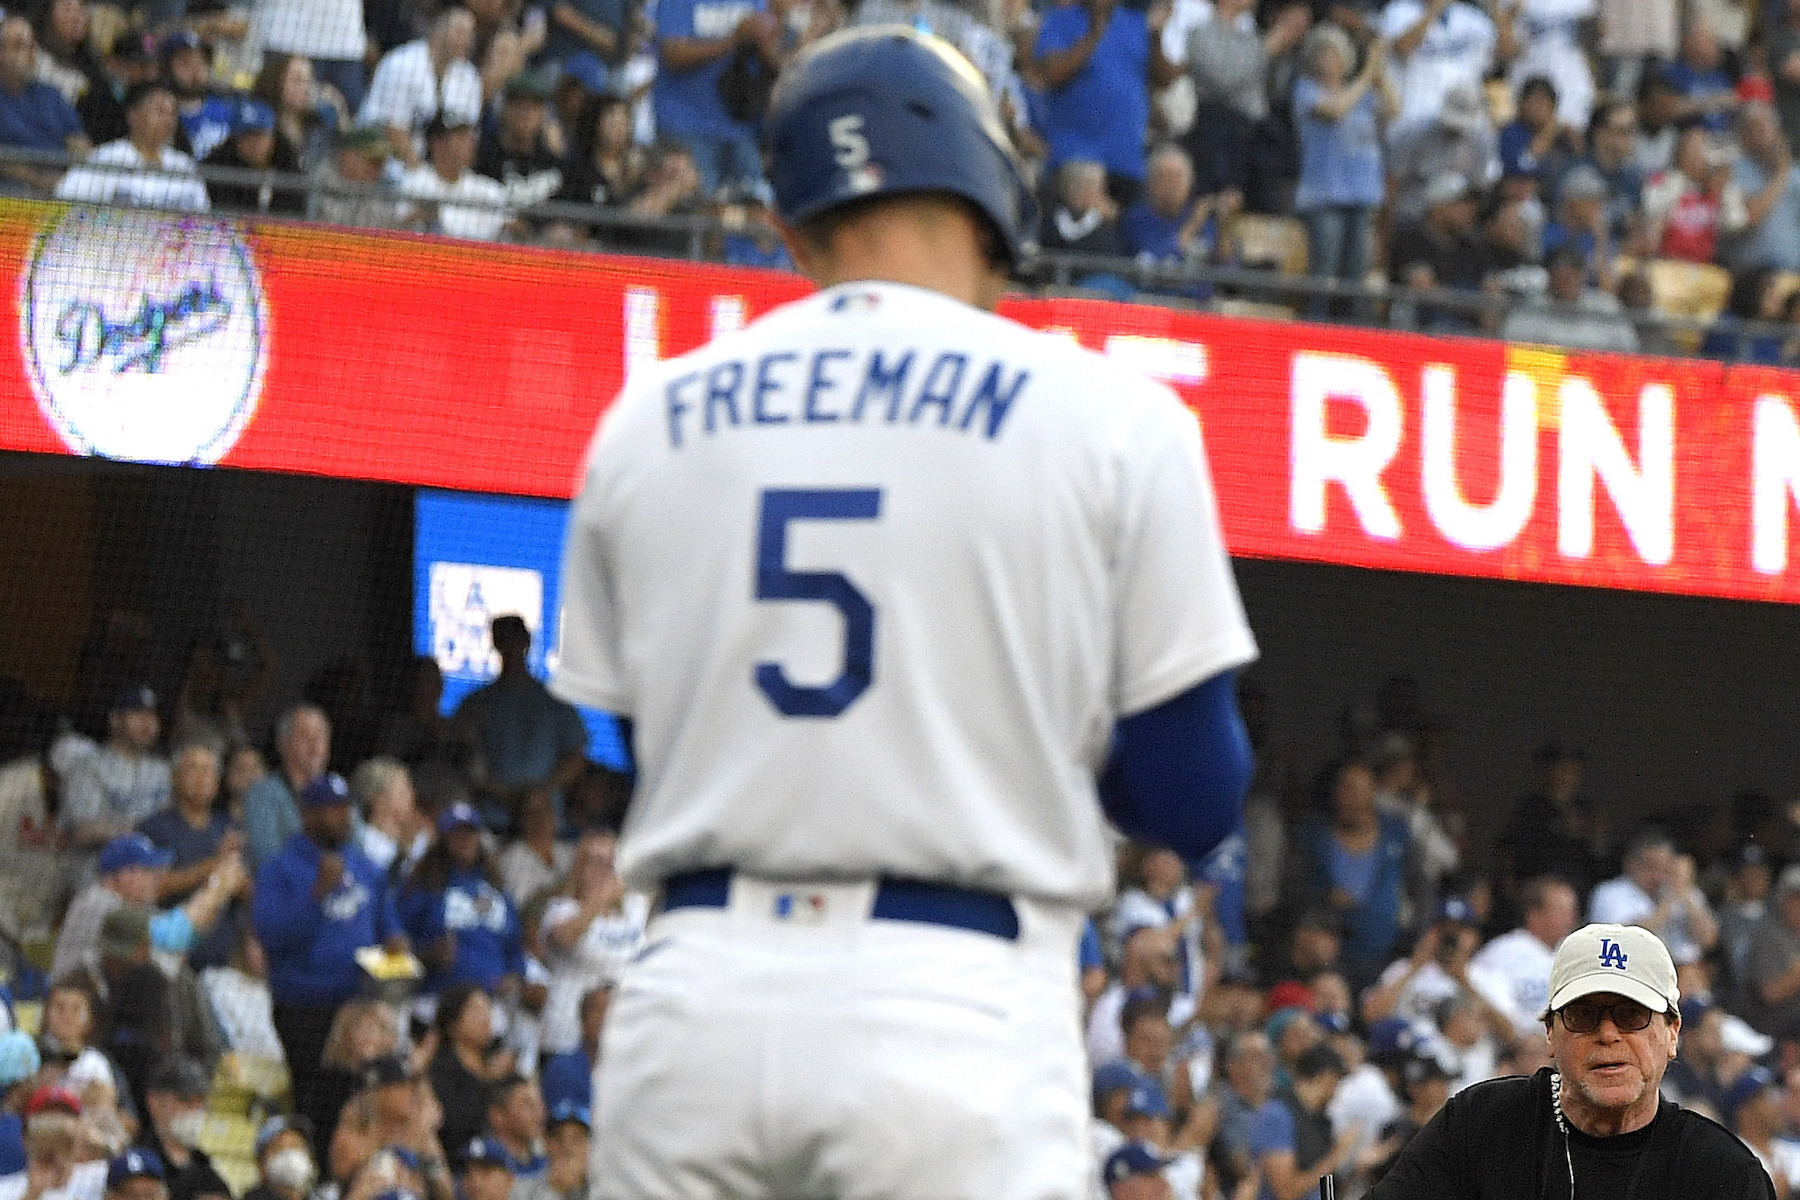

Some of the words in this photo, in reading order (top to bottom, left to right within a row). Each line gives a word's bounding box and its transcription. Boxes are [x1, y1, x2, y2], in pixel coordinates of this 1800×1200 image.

[828, 114, 870, 170] 5
[663, 348, 1035, 450] FREEMAN
[1289, 350, 1677, 566] RUN
[752, 486, 885, 720] 5
[1598, 938, 1628, 970] LA
